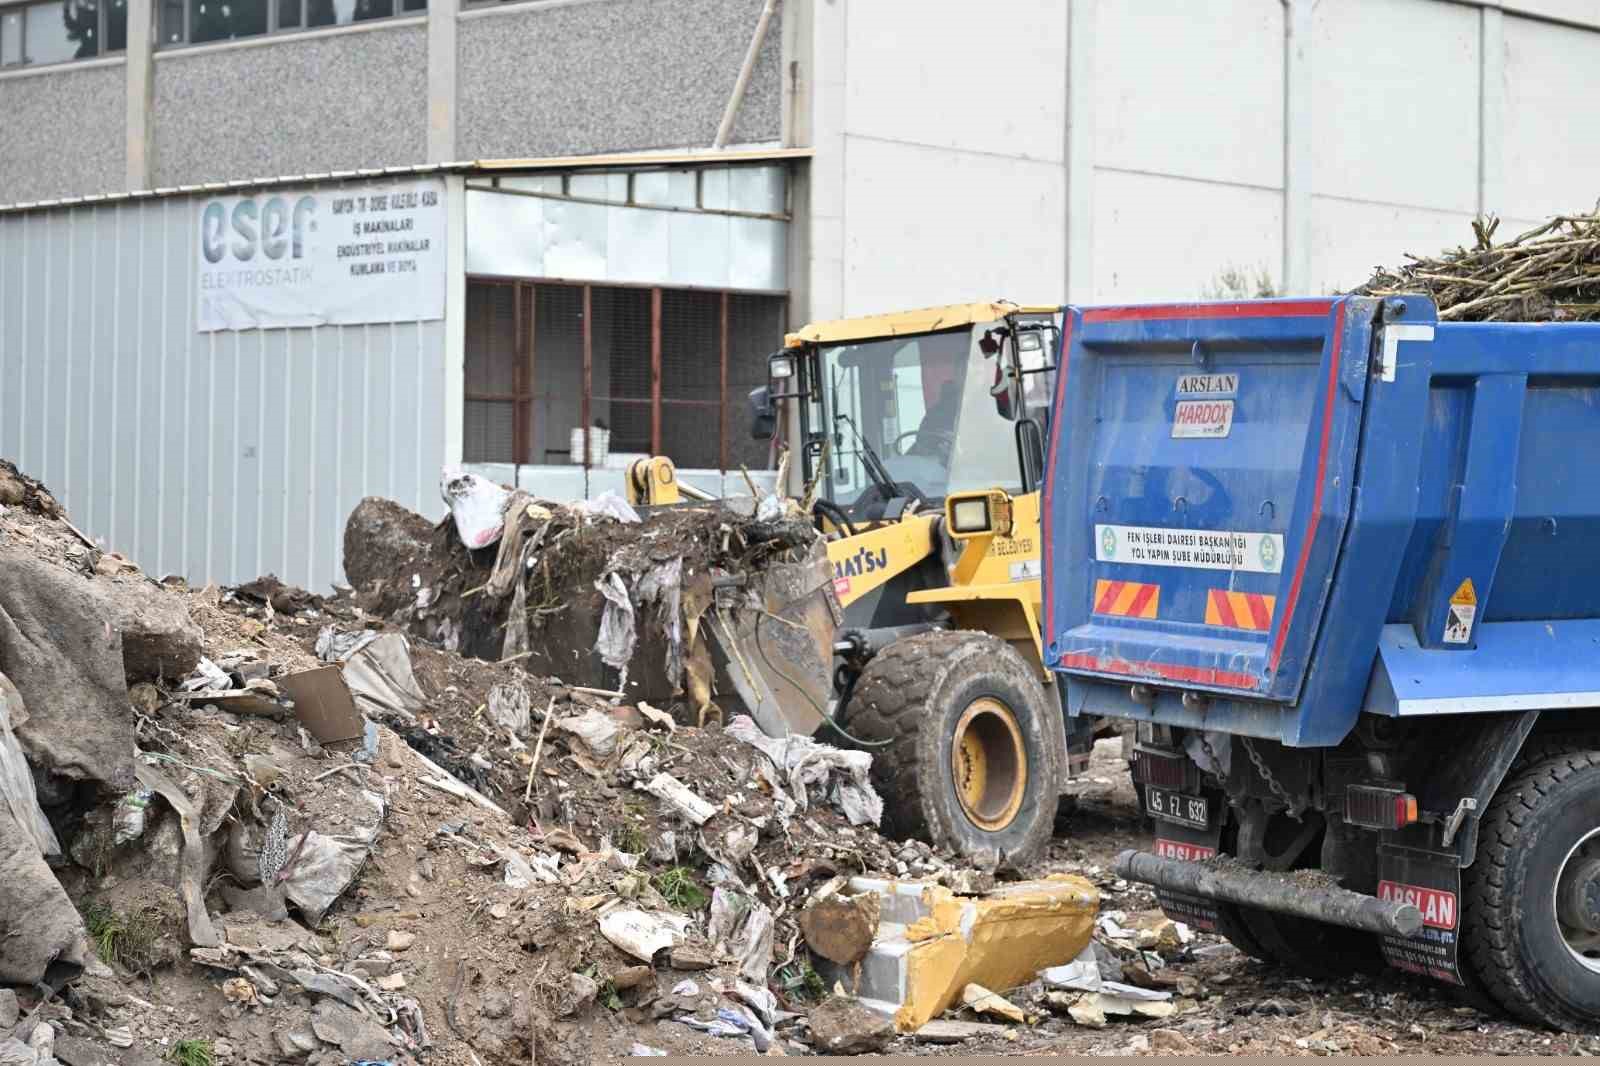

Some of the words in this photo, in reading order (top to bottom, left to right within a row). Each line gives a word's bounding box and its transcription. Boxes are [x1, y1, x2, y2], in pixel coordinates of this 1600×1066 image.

[202, 196, 318, 264] eser
[1179, 375, 1235, 392] ARSLAN
[1177, 403, 1230, 424] HARDOX
[1127, 531, 1141, 544] FEN
[1199, 535, 1247, 549] BAŞKANIĞI
[1131, 547, 1145, 560] YOL
[1147, 548, 1170, 561] YAPIM
[1152, 790, 1163, 812] 45
[1169, 795, 1182, 817] FZ
[1188, 799, 1207, 822] 632
